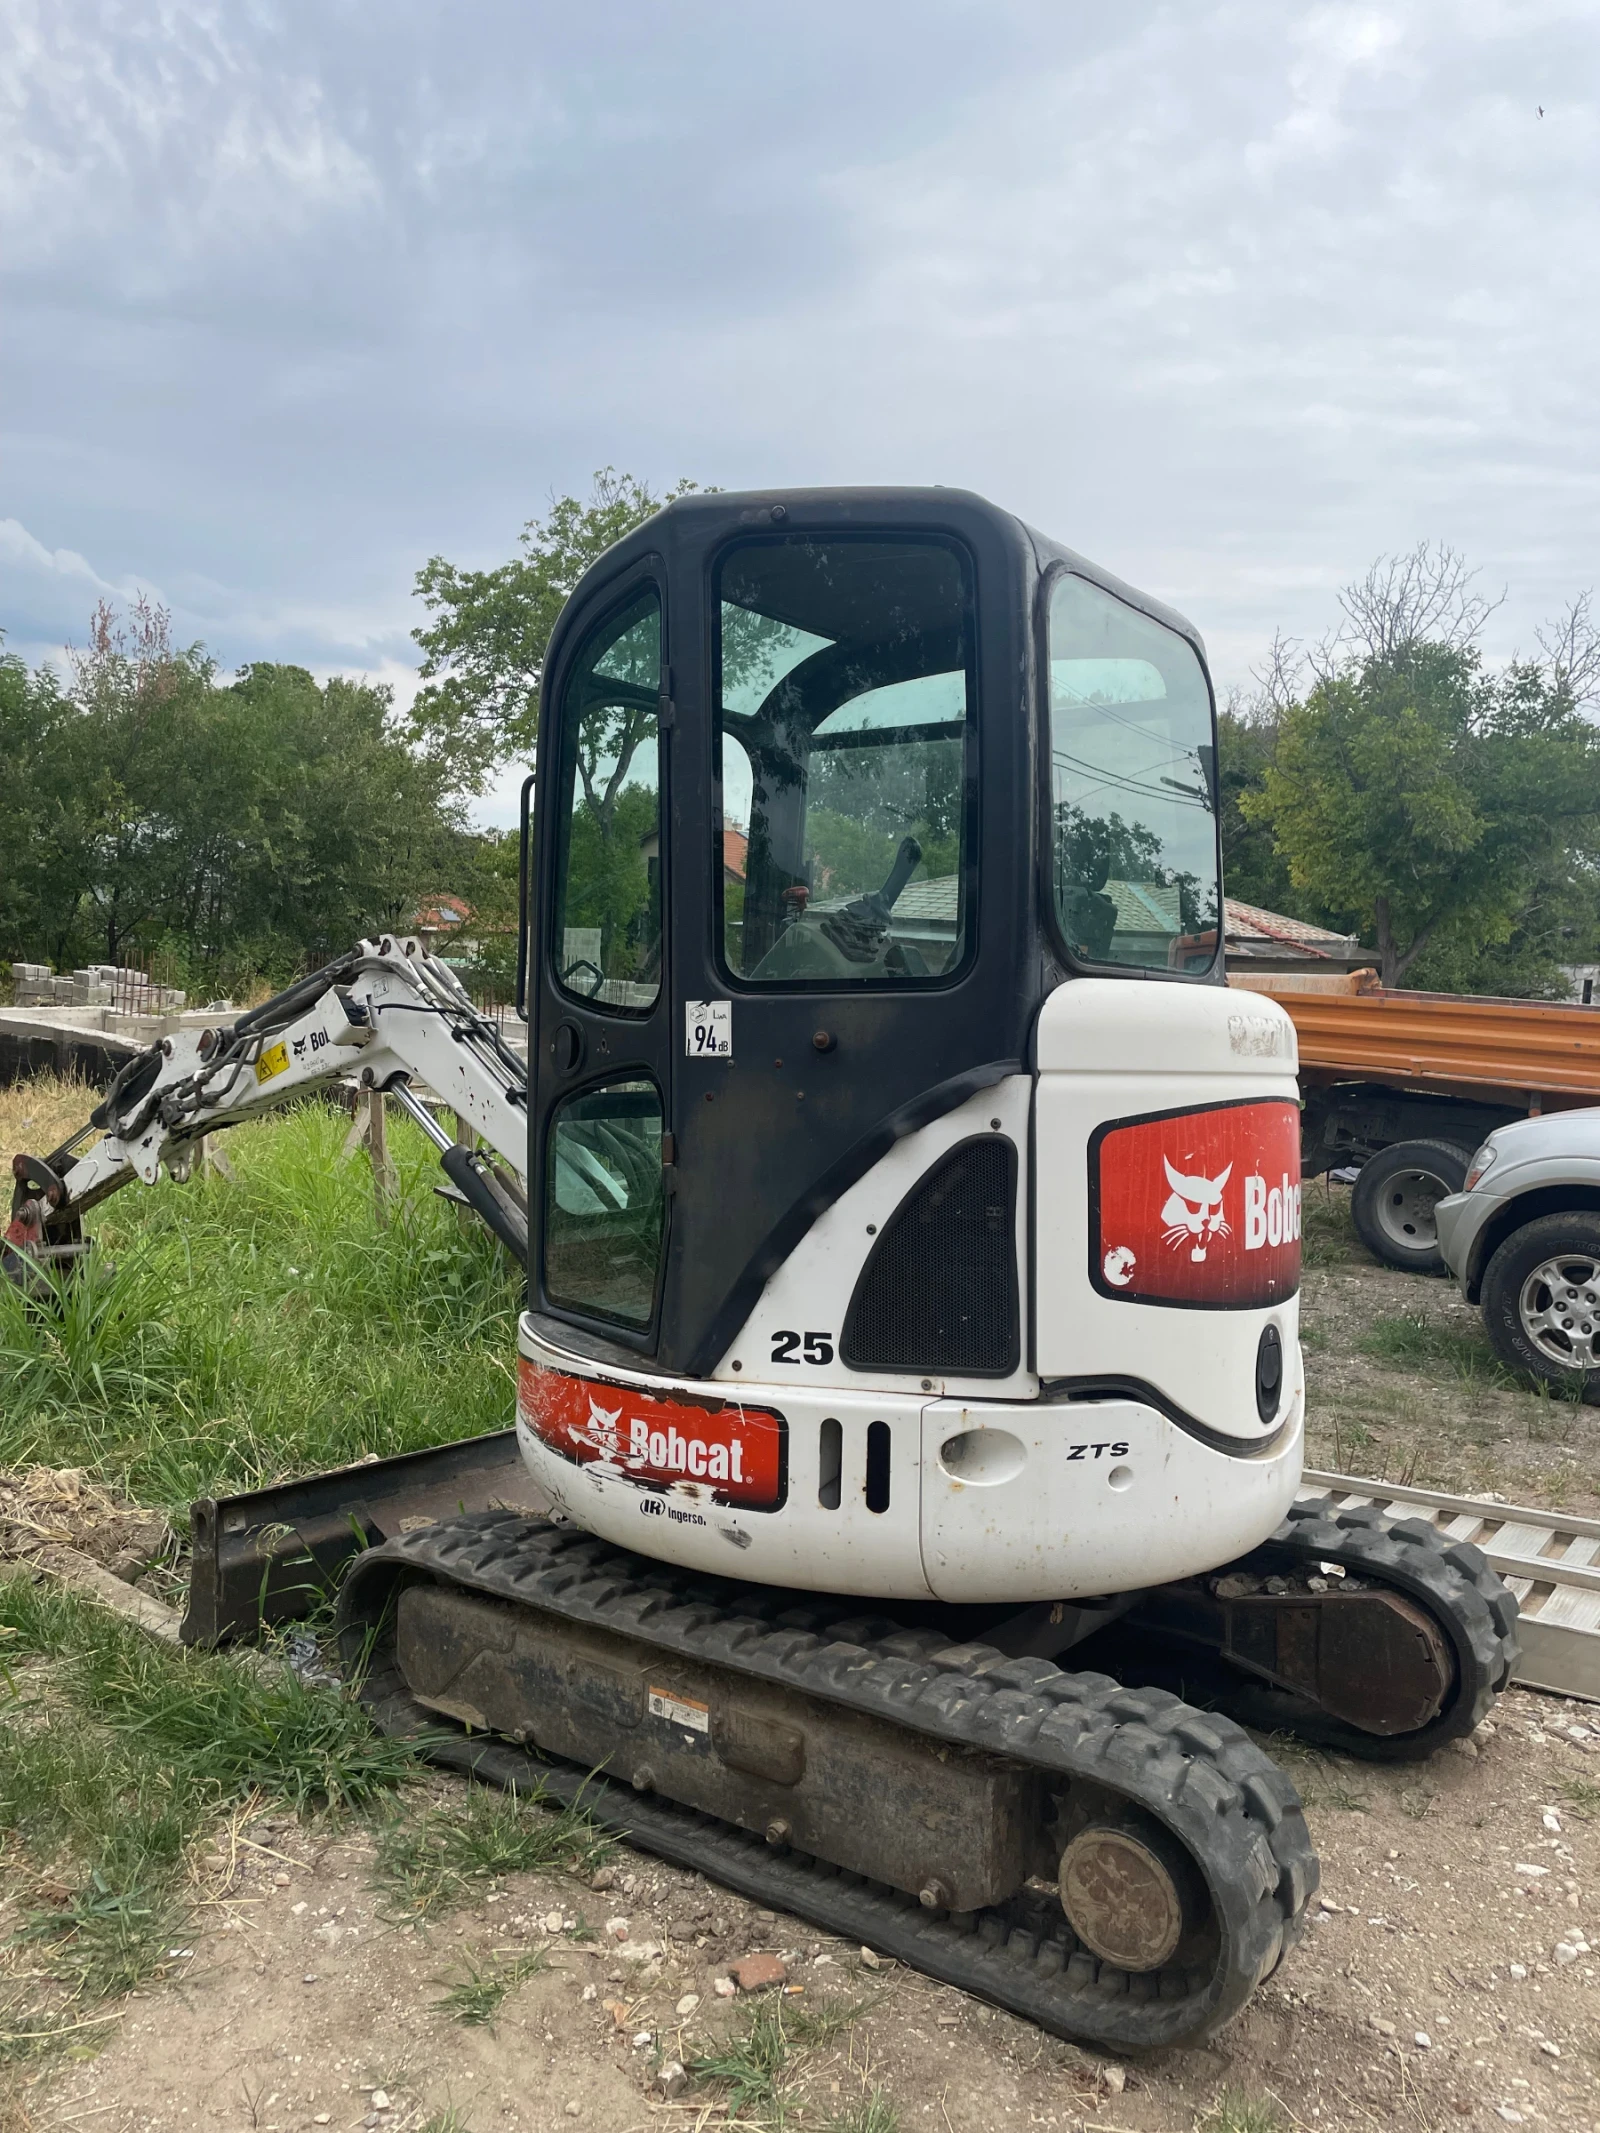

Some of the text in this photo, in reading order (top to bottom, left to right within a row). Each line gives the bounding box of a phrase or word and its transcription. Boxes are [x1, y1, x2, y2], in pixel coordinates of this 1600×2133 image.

[695, 1025, 729, 1052] 94 dB
[771, 1330, 834, 1365] 25
[629, 1417, 744, 1484] Bobcat
[1066, 1442, 1130, 1461] ZTS
[668, 1506, 707, 1526] Ingerso
